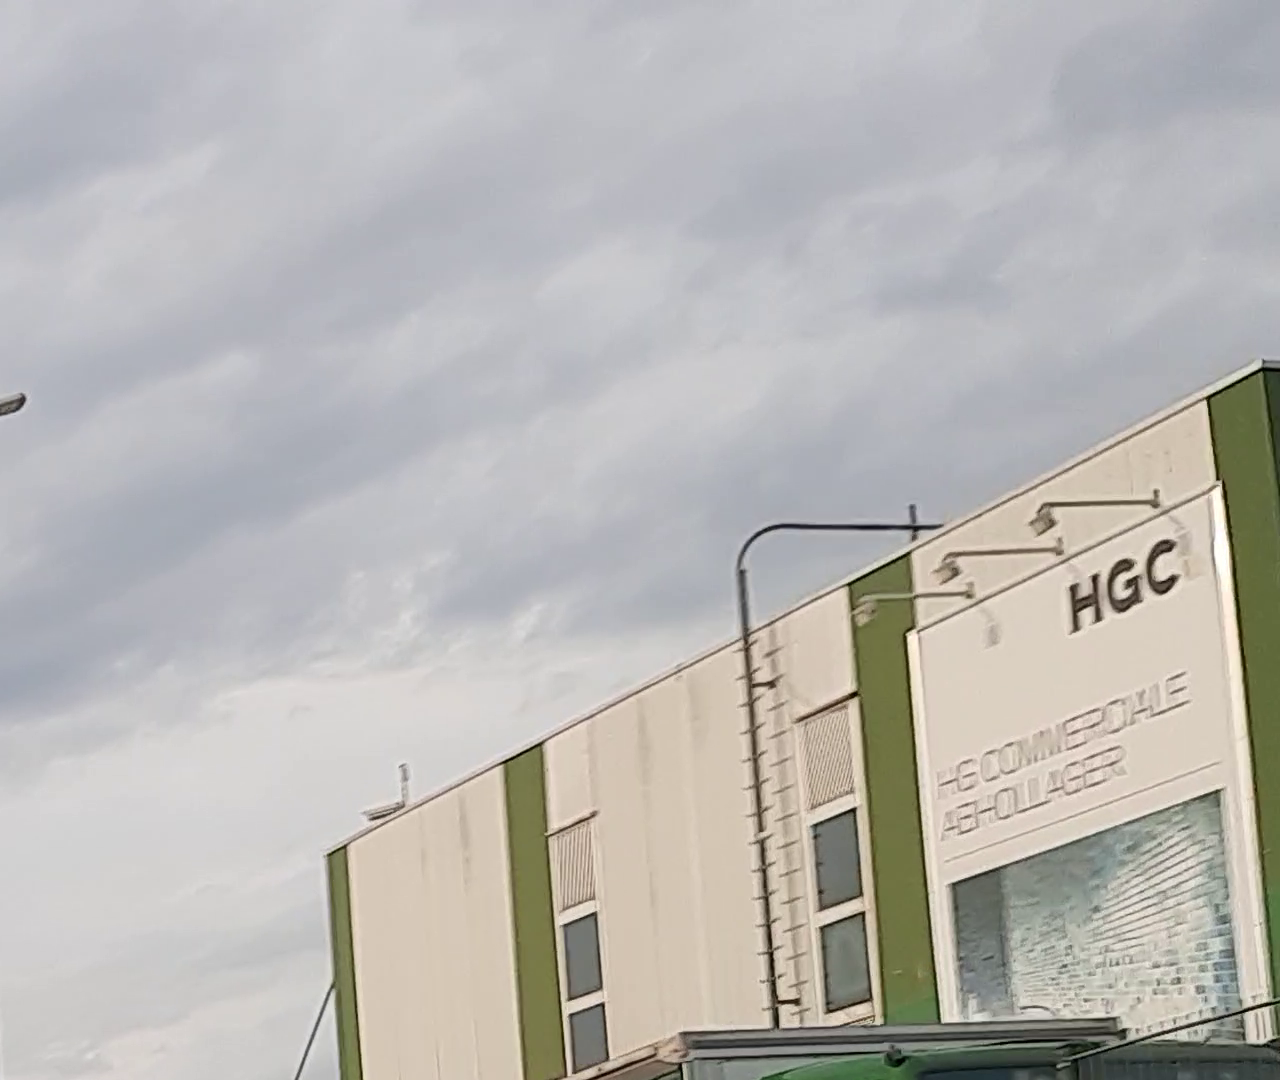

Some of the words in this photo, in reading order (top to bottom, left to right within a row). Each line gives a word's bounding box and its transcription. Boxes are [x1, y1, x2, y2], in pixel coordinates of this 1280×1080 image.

[1067, 538, 1182, 635] HGC
[980, 670, 1192, 784] COMMERCIALE
[940, 744, 1128, 842] ABHOLLAGER
